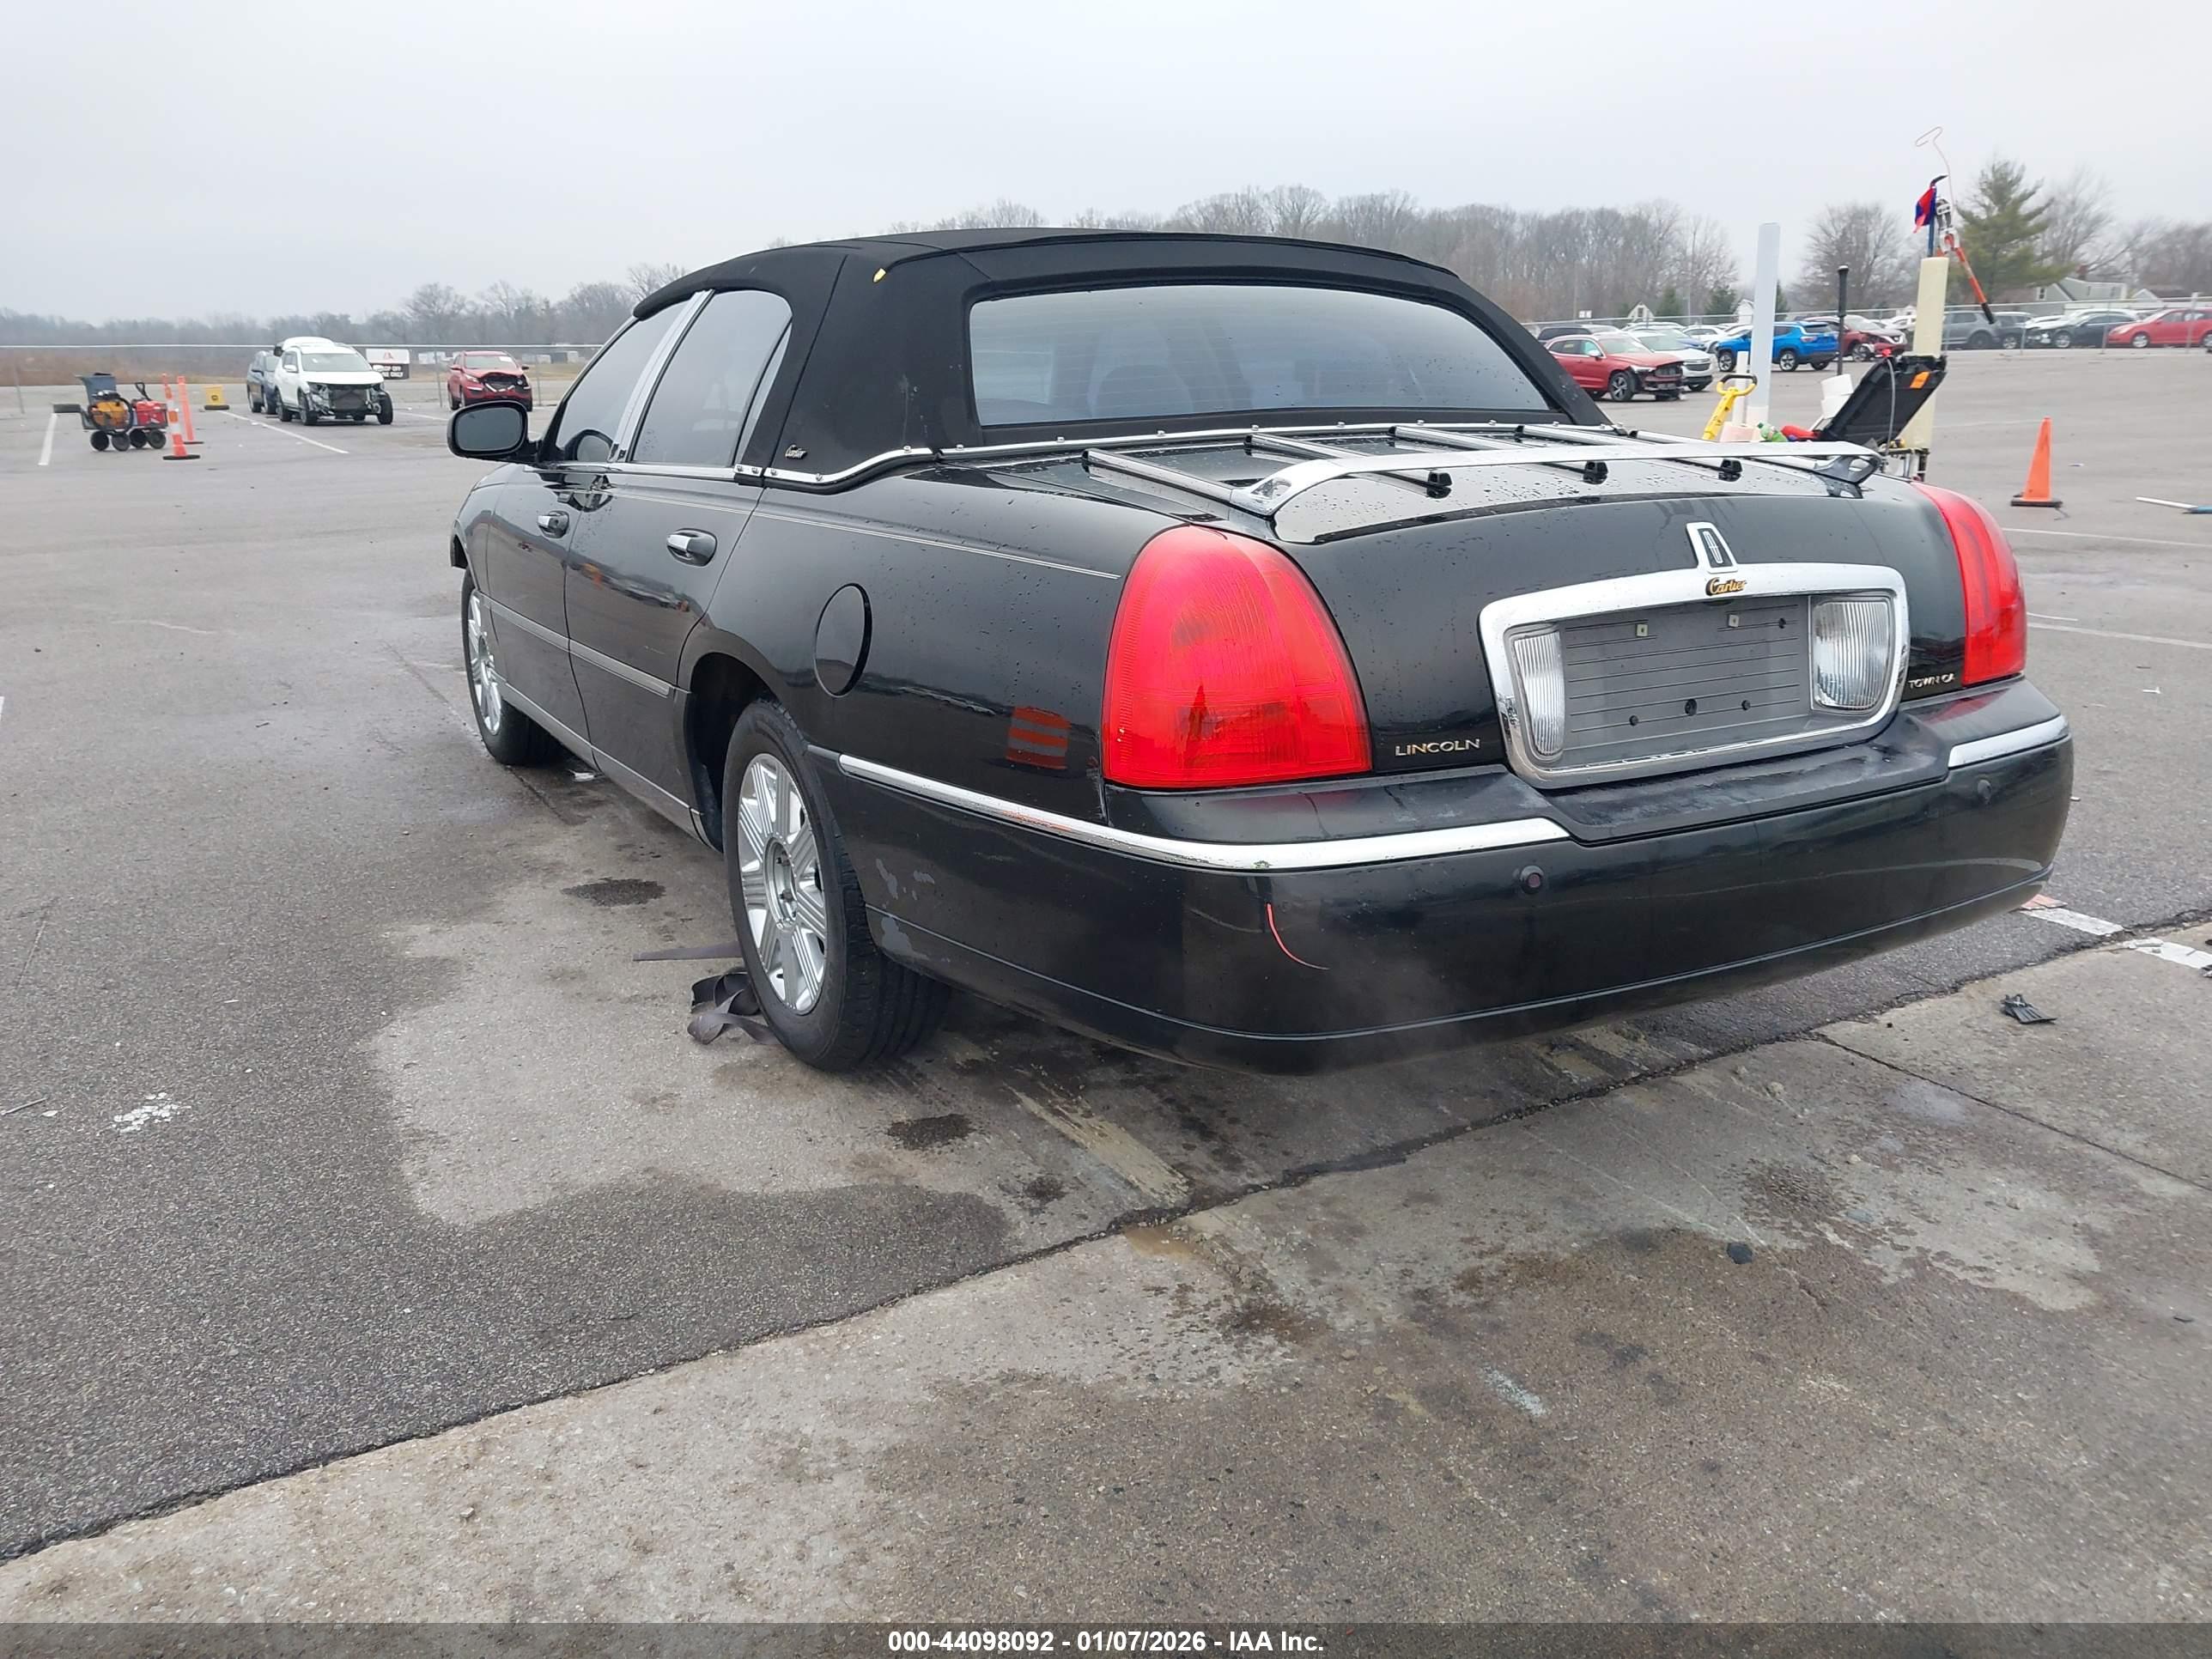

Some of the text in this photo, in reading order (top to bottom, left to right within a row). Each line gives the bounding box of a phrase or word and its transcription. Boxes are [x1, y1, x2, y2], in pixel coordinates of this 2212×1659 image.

[1705, 577, 1747, 596] Cartier
[1908, 676, 1941, 689] TOWN
[1395, 738, 1480, 757] LINCOLN
